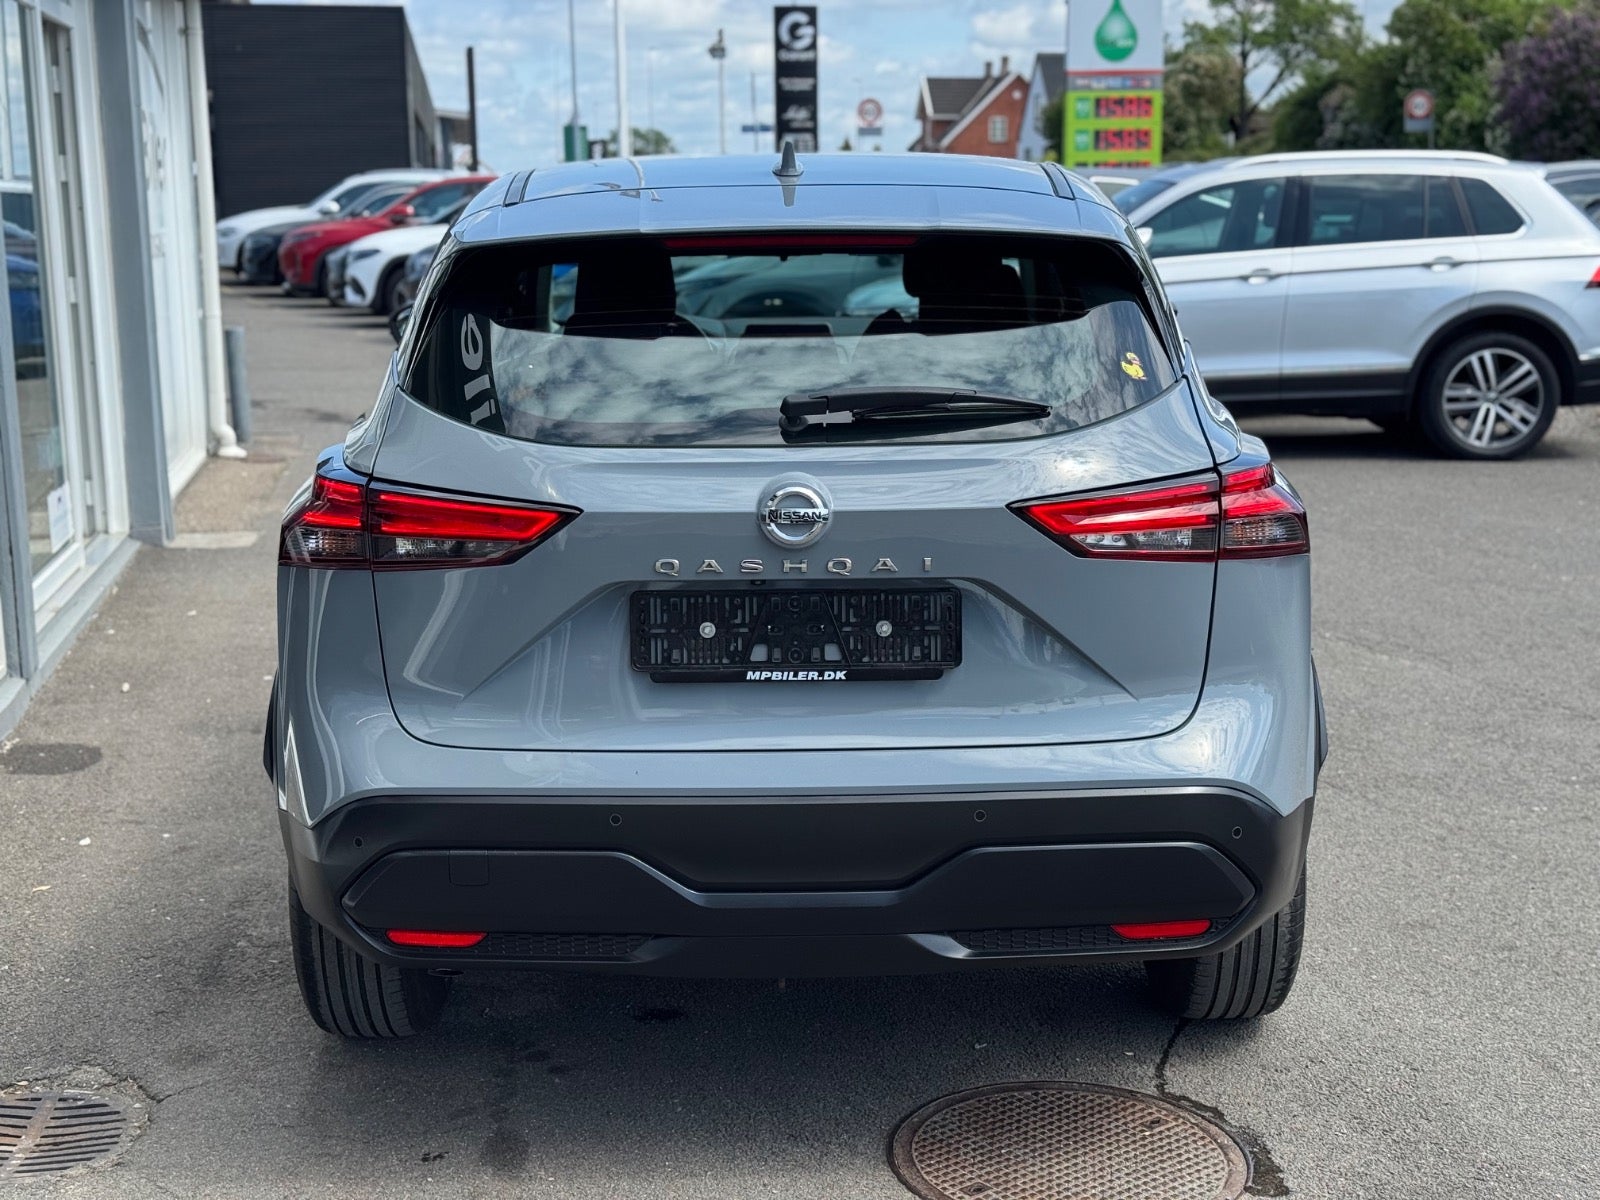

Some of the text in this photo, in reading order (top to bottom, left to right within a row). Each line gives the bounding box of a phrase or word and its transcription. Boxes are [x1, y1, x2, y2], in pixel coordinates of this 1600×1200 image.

[768, 511, 822, 520] NISSAN
[654, 557, 933, 576] QASHQAI
[745, 671, 848, 681] MPBILER.DK
